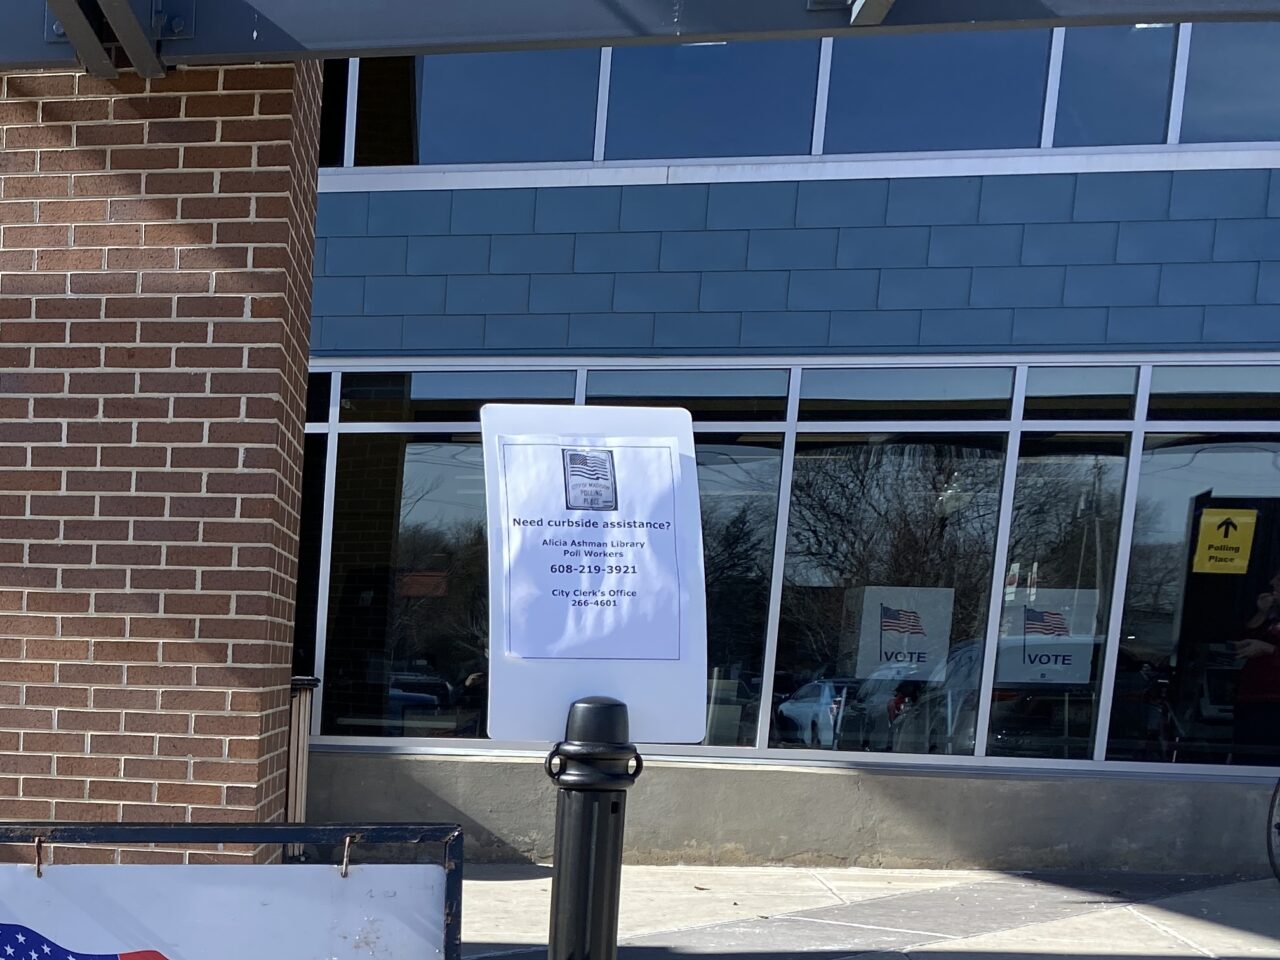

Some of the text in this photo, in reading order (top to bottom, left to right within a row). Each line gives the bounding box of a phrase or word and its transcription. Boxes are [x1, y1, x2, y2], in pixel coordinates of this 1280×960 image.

[513, 518, 671, 530] Need curbside assistance?
[542, 539, 645, 549] Alicia Ashman Library
[1207, 544, 1240, 553] Polling
[584, 550, 624, 558] Workers
[1208, 555, 1236, 563] Place
[550, 564, 638, 575] 608-219-3921
[552, 589, 637, 598] City Clerk's Office
[884, 651, 928, 663] VOTE
[1027, 653, 1072, 666] VOTE
